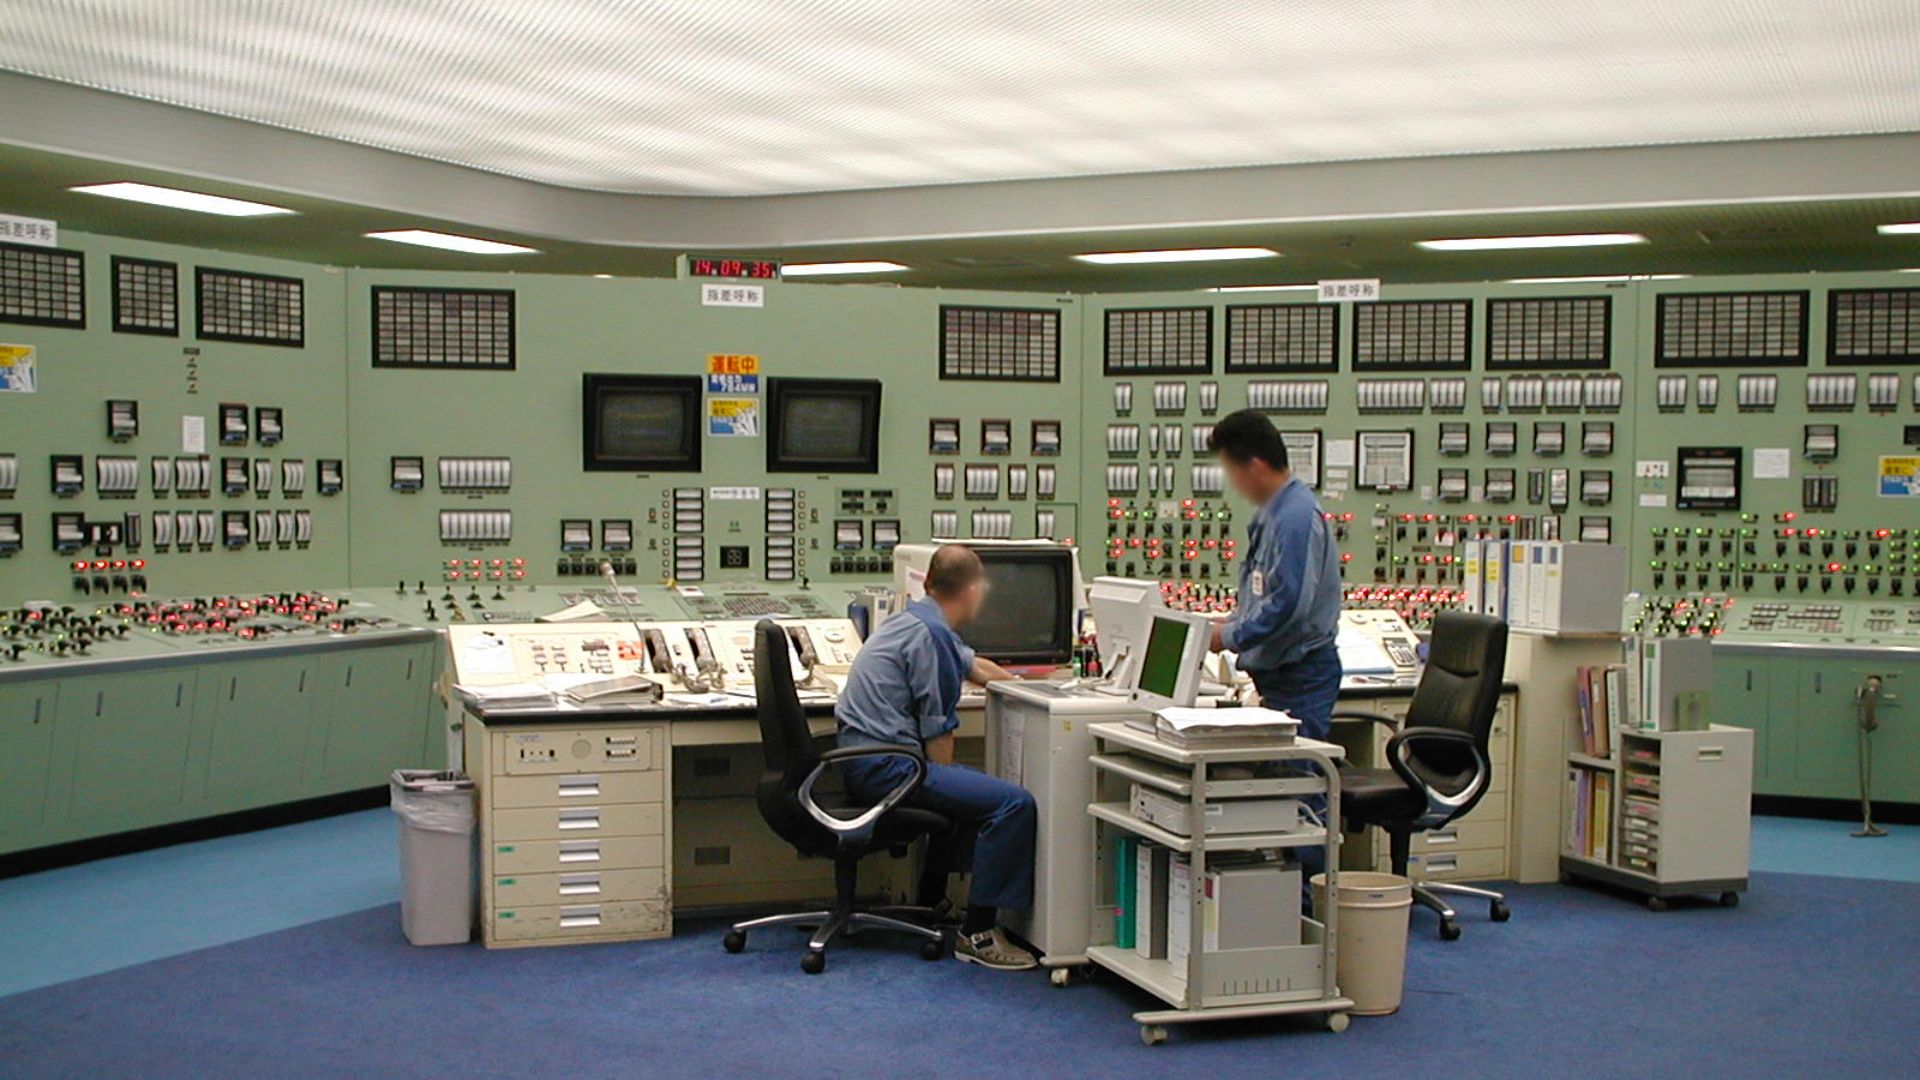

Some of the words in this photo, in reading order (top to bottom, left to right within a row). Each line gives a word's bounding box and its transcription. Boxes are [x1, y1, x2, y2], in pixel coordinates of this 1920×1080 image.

[707, 289, 759, 302] 指差呼称
[712, 355, 755, 374] 運転中
